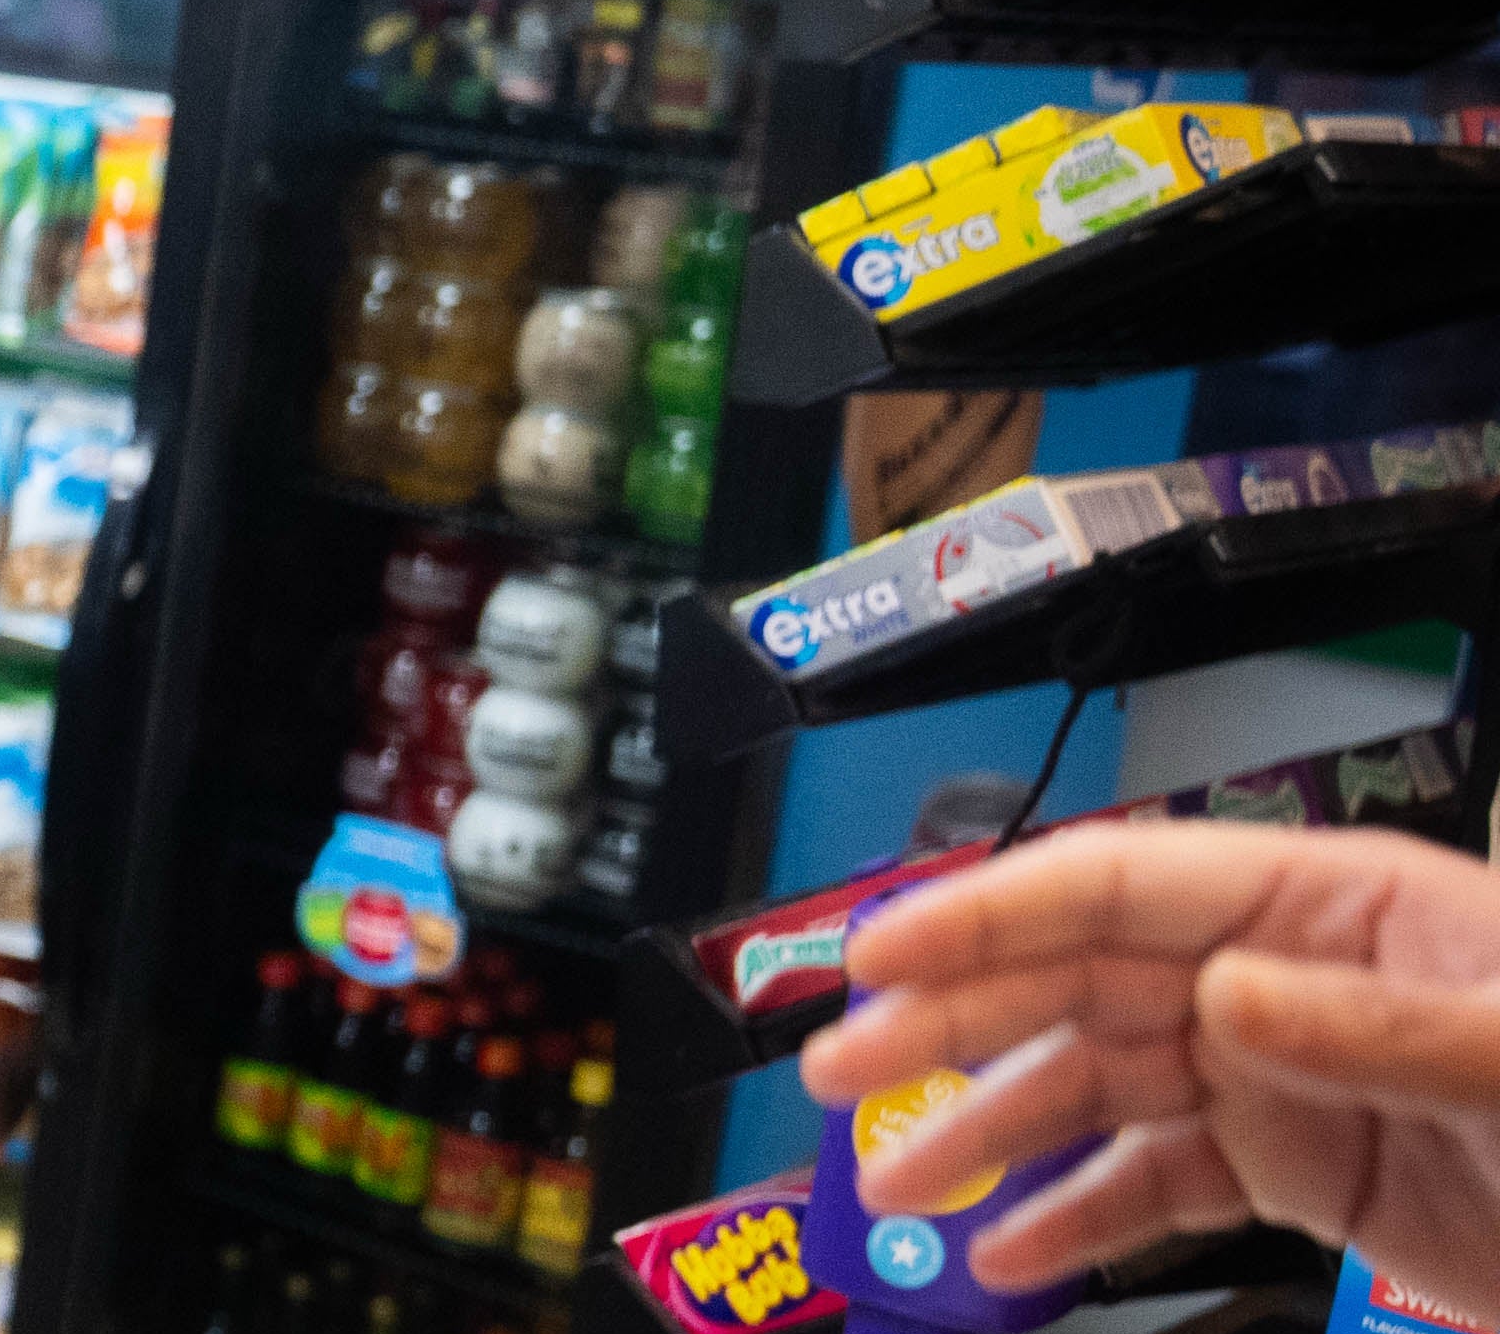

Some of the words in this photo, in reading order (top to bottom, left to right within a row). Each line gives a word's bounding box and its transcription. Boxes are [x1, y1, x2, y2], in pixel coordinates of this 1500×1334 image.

[851, 213, 1000, 298] extra
[763, 580, 900, 658] extra
[670, 1206, 798, 1303] Hubba
